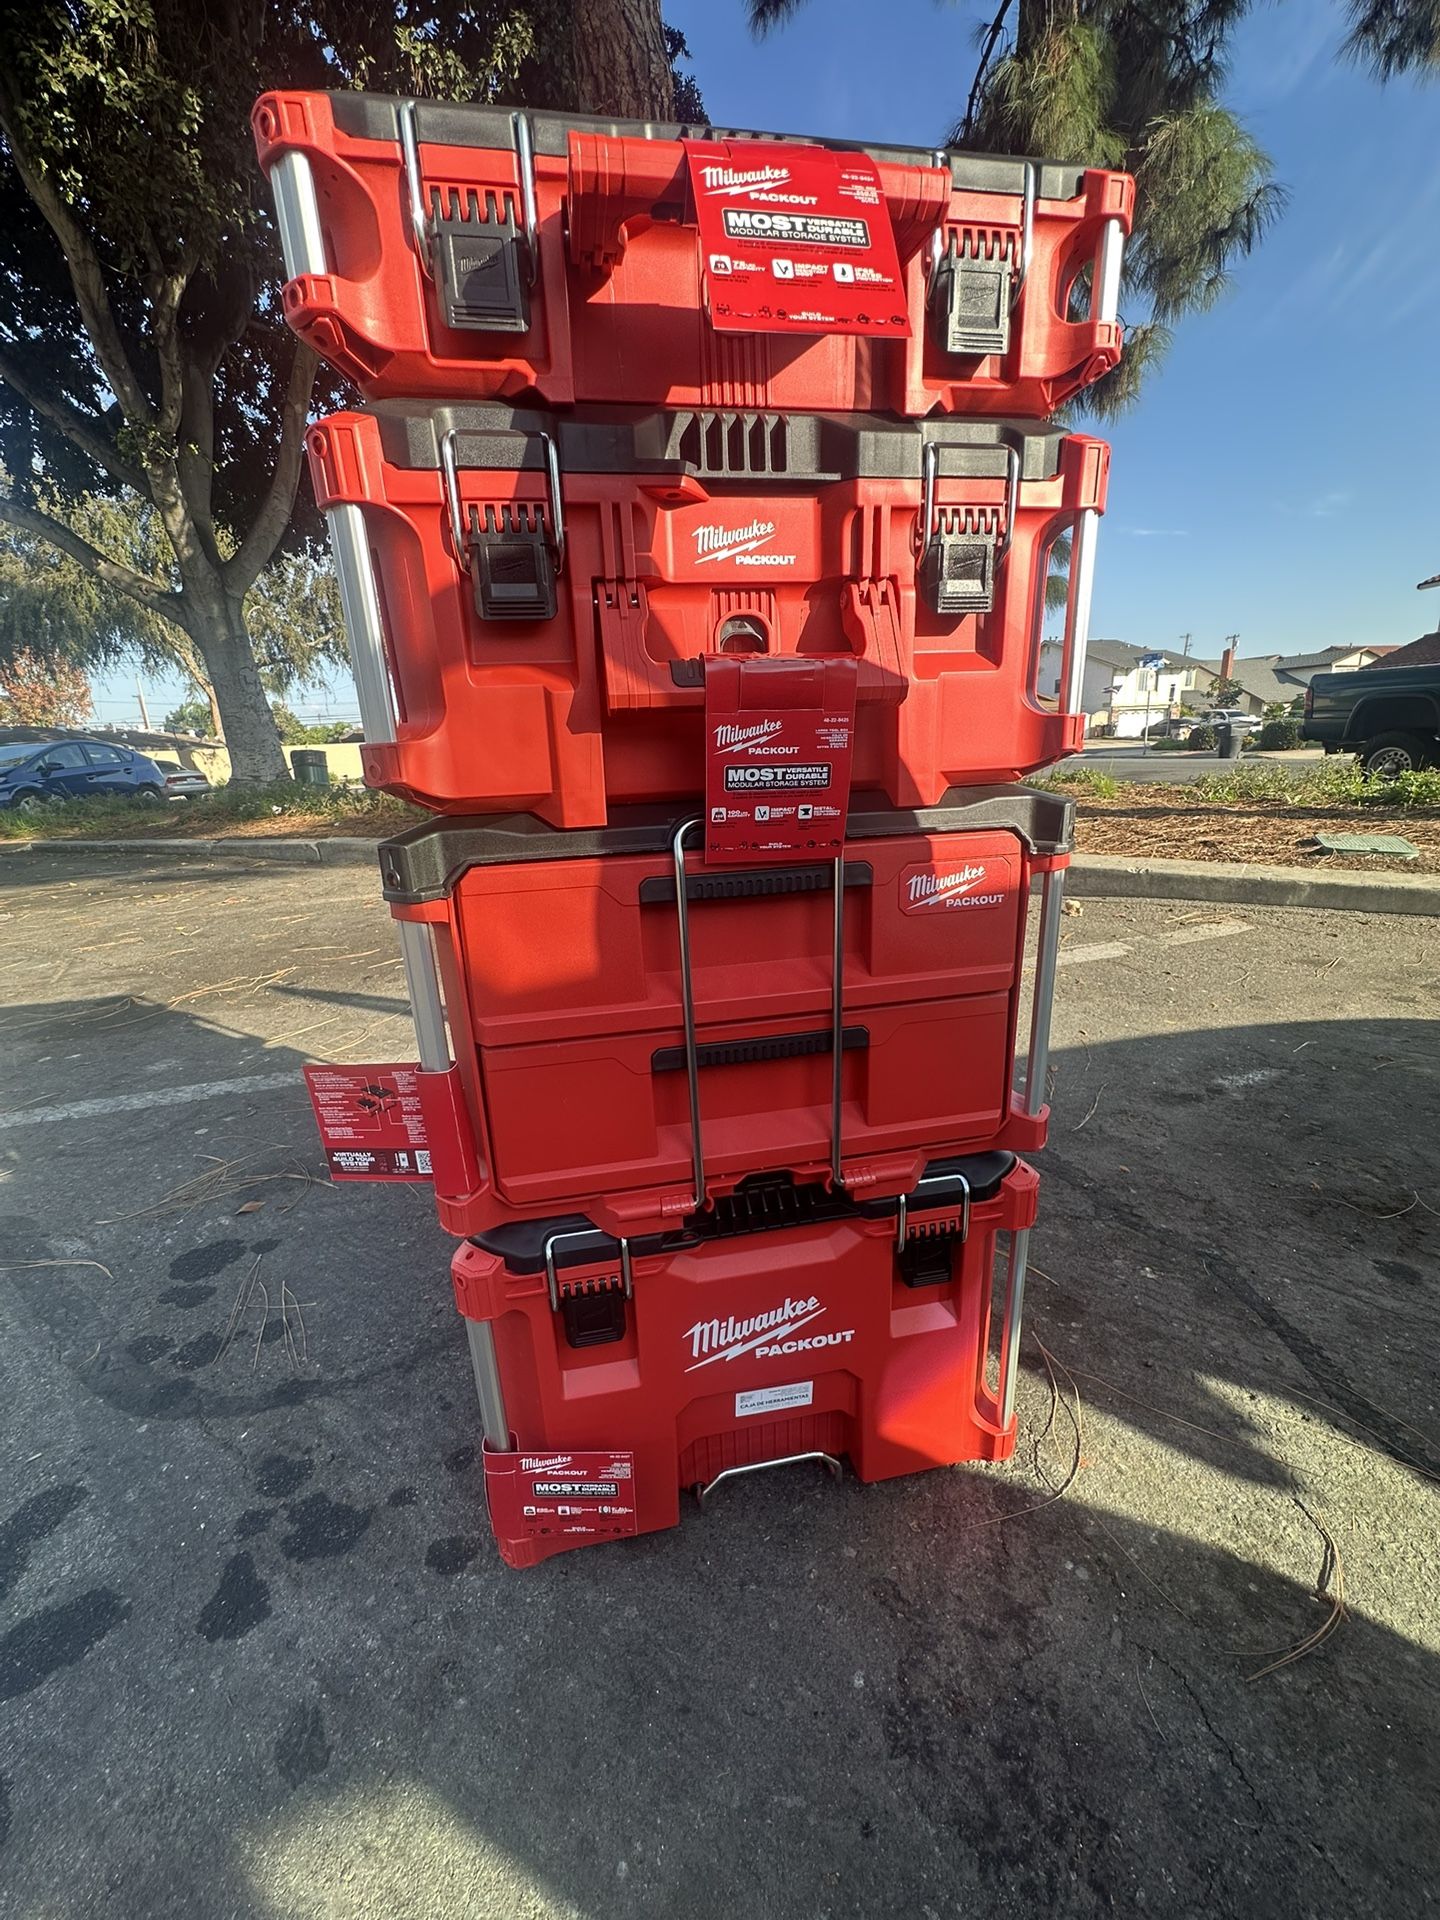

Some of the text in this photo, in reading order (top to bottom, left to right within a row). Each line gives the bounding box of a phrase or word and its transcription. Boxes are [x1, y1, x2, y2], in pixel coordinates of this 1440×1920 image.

[699, 165, 790, 188] Milwaukee
[750, 192, 818, 205] PACKOUT
[727, 212, 863, 232] MOST VERSATILE
[730, 227, 866, 245] MODULAR STORAGE SYSTEM
[807, 225, 865, 237] DURABLE
[794, 263, 828, 271] IMPACT
[691, 519, 775, 554] Milwaukee
[735, 555, 796, 565] PACKOUT
[712, 719, 782, 747] Milwaukee
[748, 747, 800, 755] PACKOUT
[728, 768, 786, 781] MOST
[906, 865, 986, 901] Milwaukee
[946, 894, 1005, 907] PACKOUT
[682, 1296, 820, 1358] Milwaukee
[755, 1330, 855, 1358] PACKOUT
[765, 1393, 809, 1404] HERRAMIENTAS
[519, 1455, 573, 1470] Milwaukee
[535, 1483, 581, 1491] MOST
